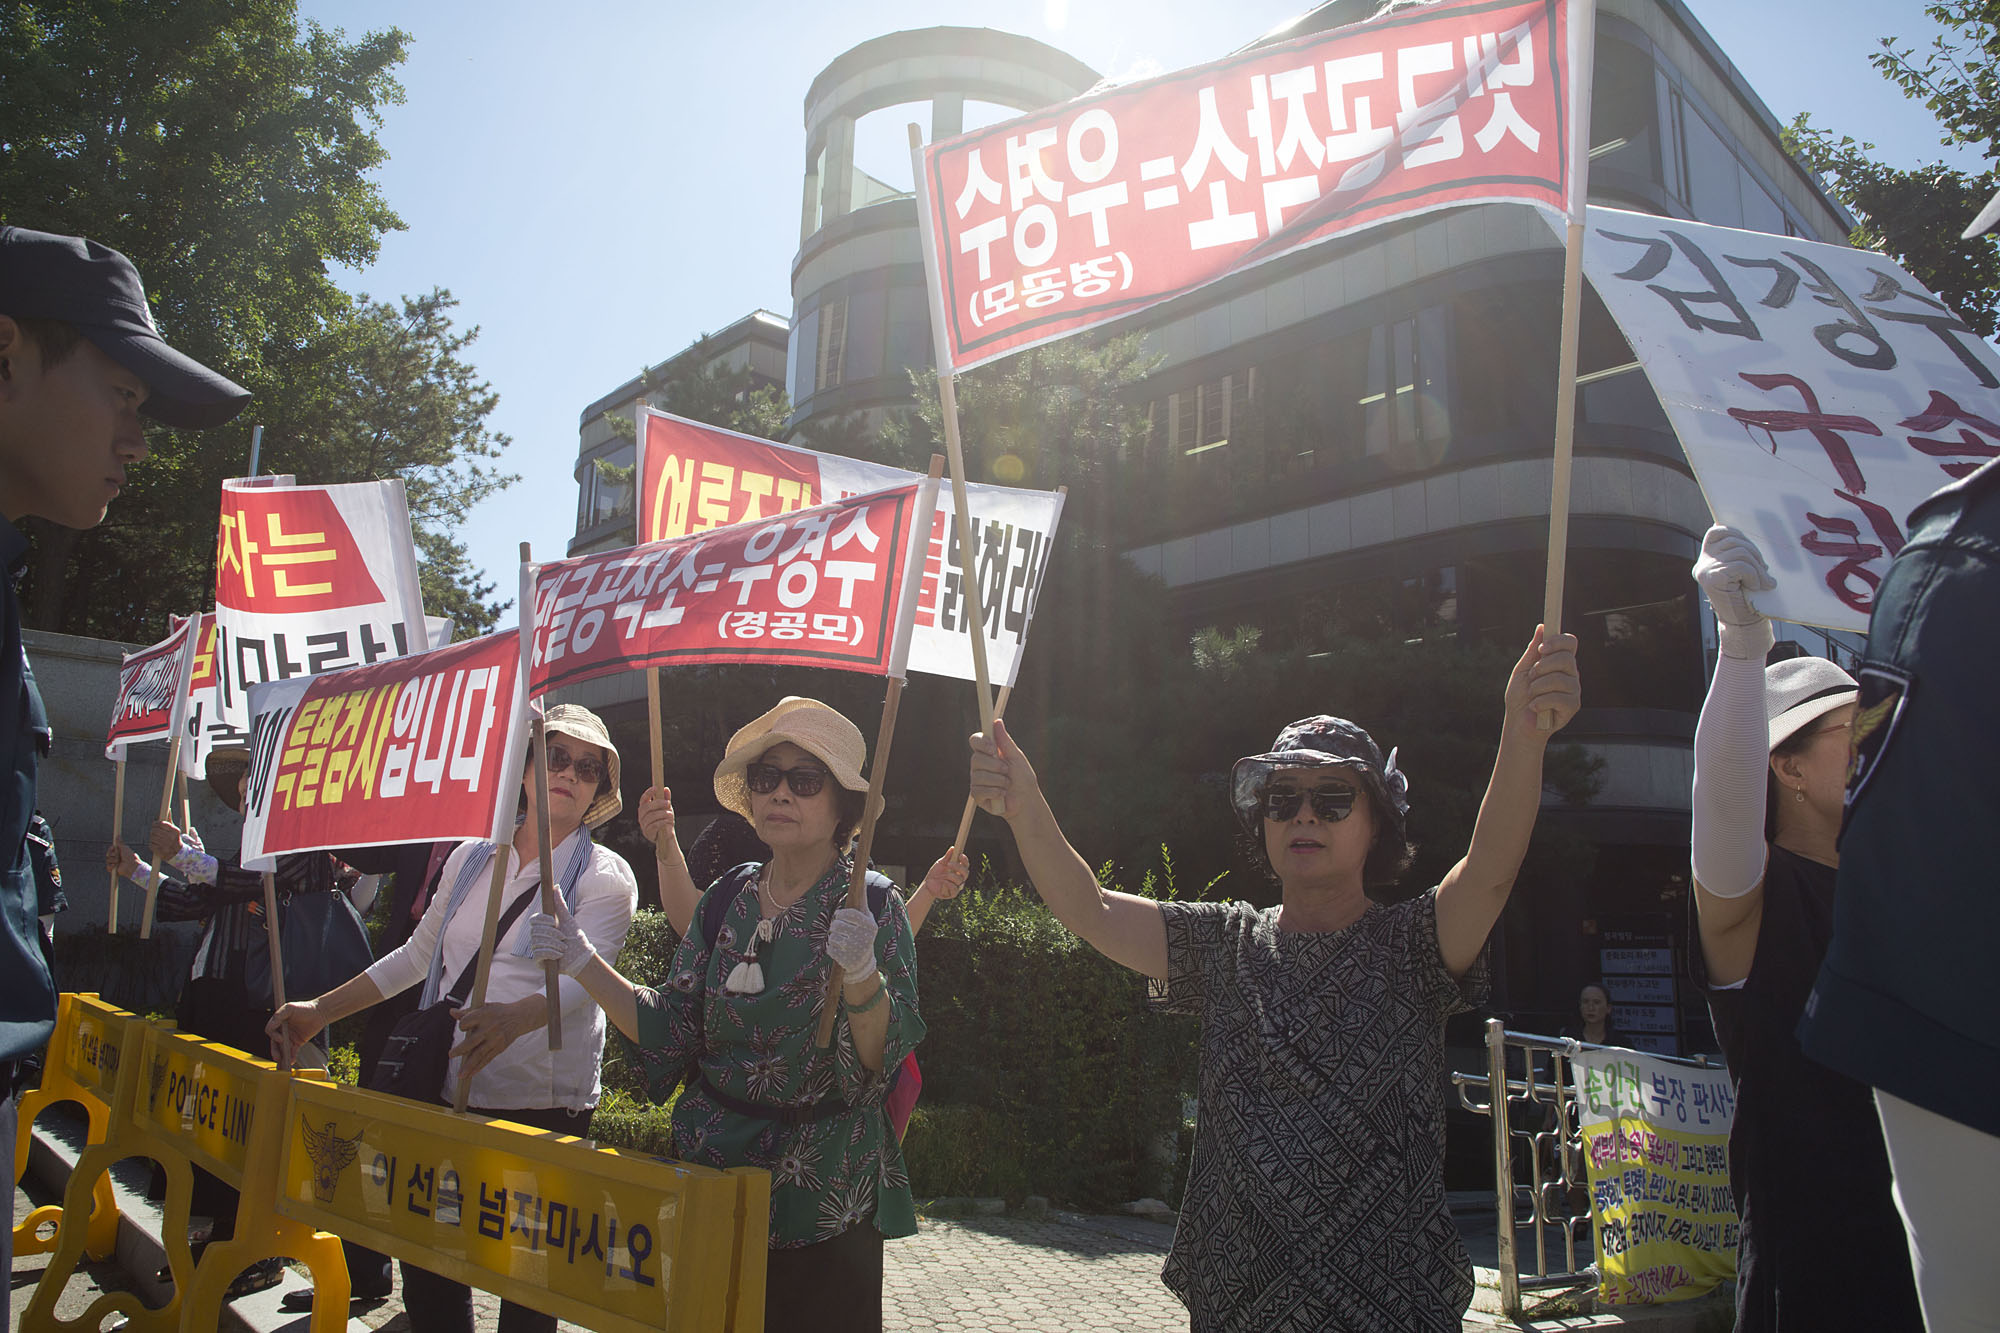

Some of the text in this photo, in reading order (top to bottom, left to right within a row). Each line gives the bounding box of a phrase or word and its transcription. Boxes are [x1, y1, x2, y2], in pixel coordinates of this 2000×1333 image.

[717, 610, 865, 646] (경공모)
[276, 665, 500, 811] 특별검사입니다
[167, 1071, 255, 1147] POLICE LIN
[1651, 1071, 1687, 1123] 부장
[371, 1153, 655, 1288] 이 선을 넘지마시오
